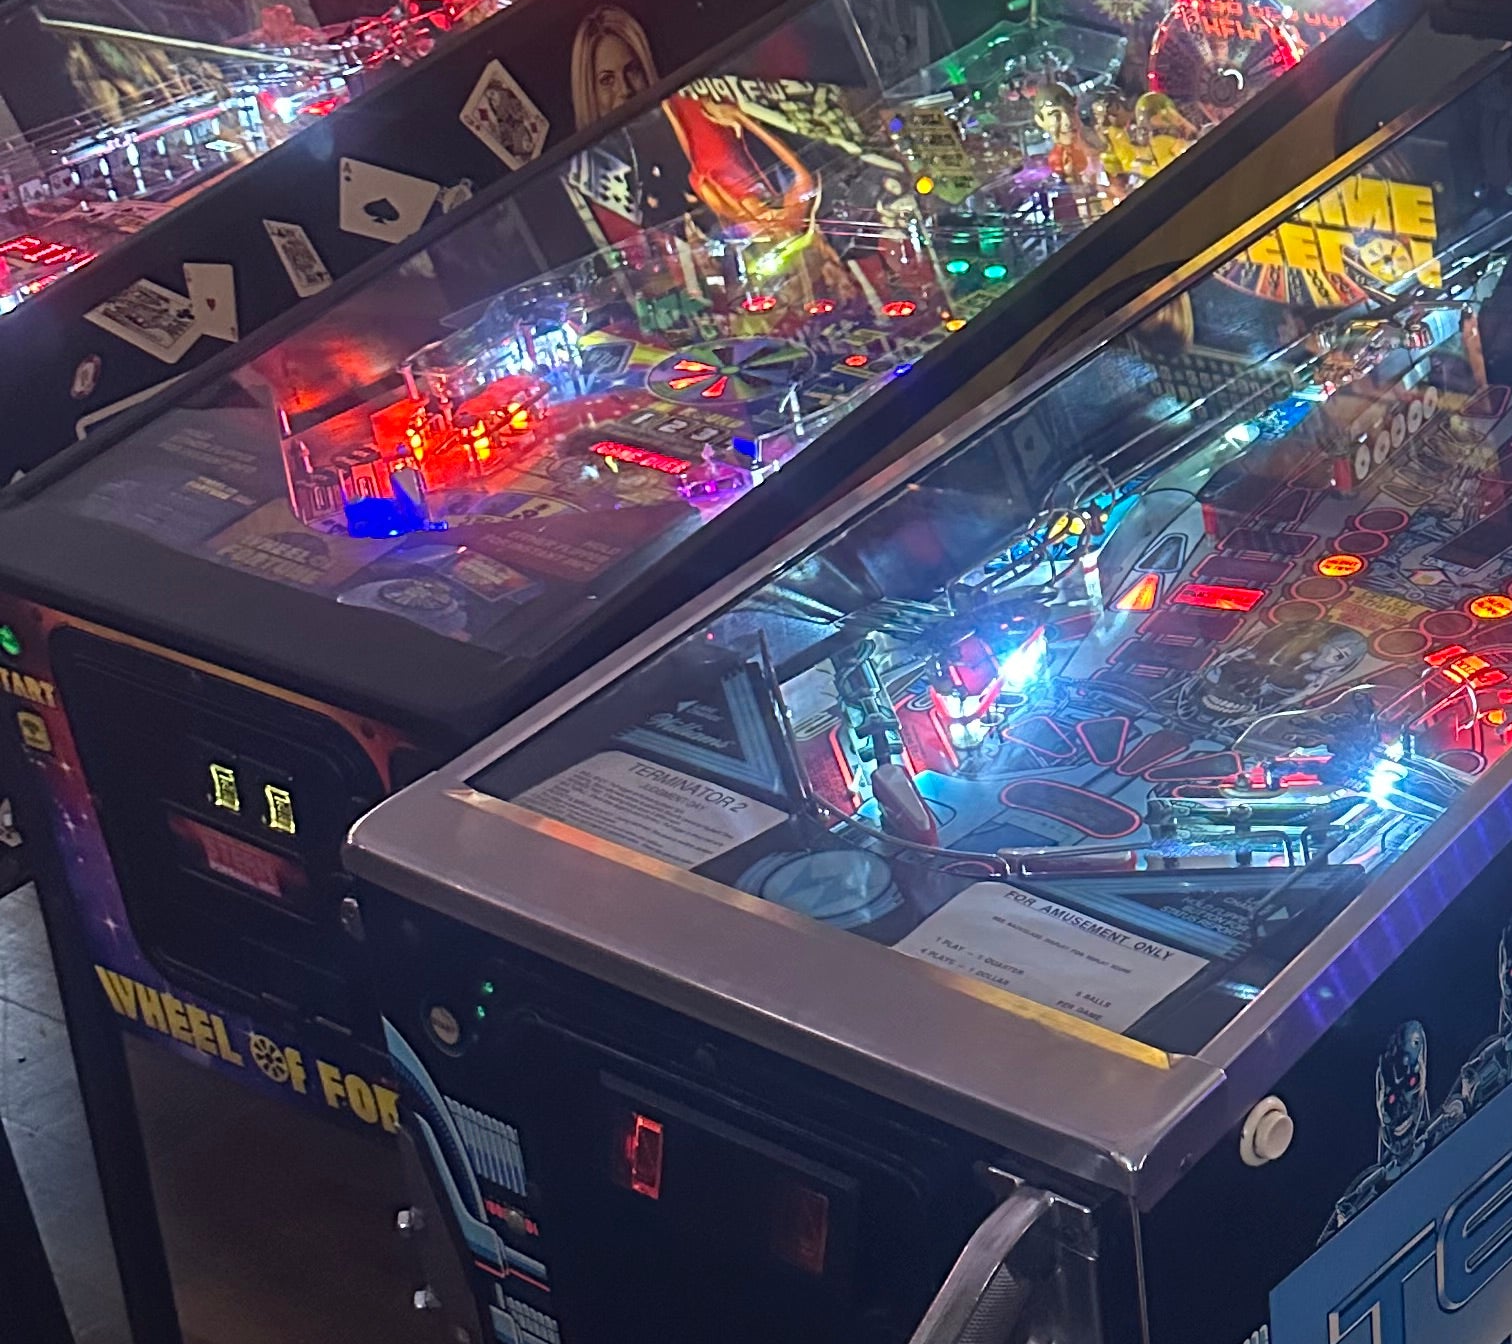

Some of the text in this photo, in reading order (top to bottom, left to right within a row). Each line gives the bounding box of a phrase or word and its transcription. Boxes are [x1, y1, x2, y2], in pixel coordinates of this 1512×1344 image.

[0, 666, 57, 709] TART
[627, 761, 749, 814] TERMINATOR 2
[1002, 890, 1176, 962] FOR AMUSEMENT ONLY
[928, 950, 958, 968] PLAYS
[975, 967, 1010, 986] DOLLAR
[943, 937, 966, 952] PLAY
[984, 956, 1025, 975] QUARTER
[1083, 994, 1112, 1008] BALLS
[95, 965, 245, 1067] WHEEL
[316, 1060, 402, 1133] FOR
